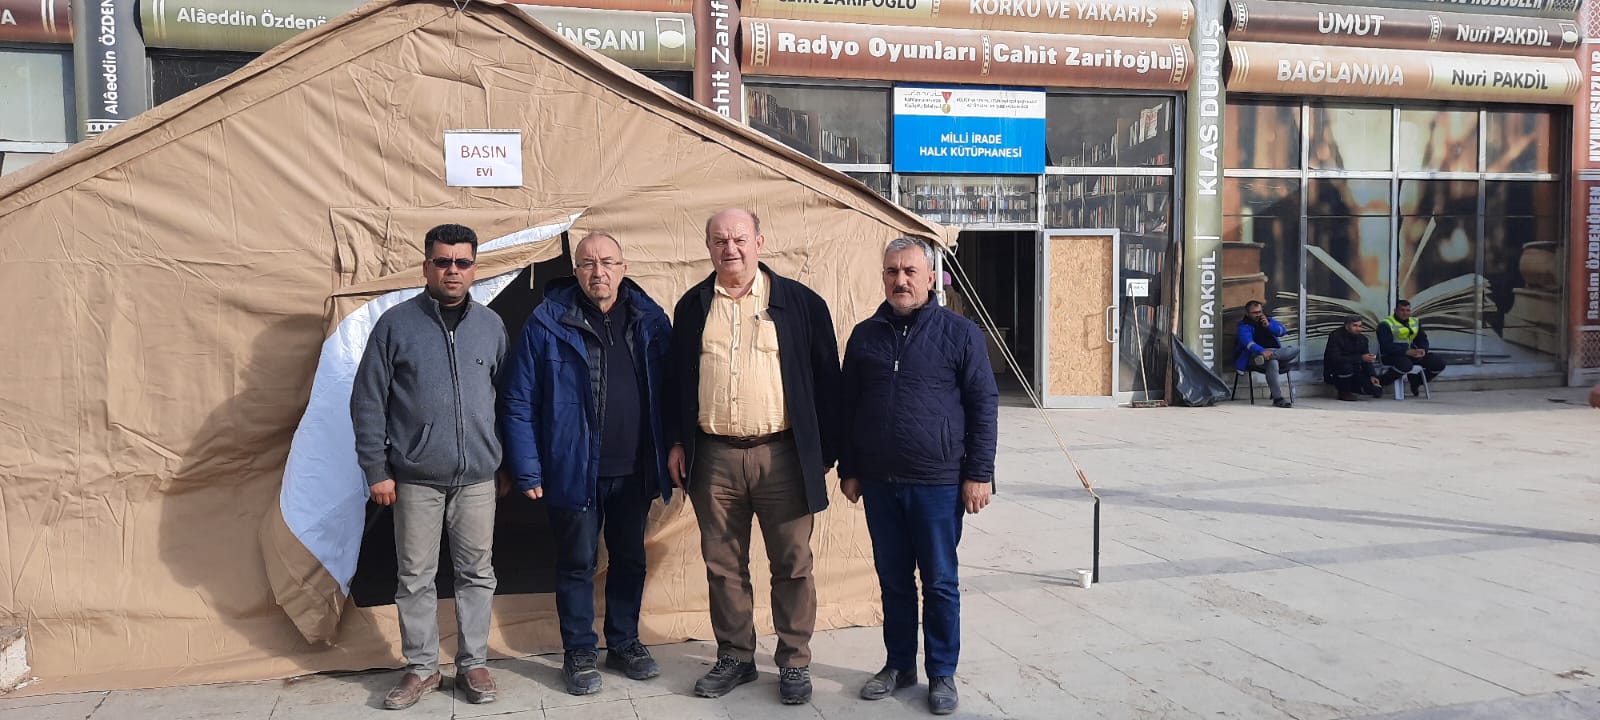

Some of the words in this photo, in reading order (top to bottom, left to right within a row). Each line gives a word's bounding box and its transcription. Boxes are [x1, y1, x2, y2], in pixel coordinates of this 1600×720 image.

[176, 7, 257, 27] Alâeddin
[969, 0, 1041, 18] KORKU
[1046, 0, 1071, 19] VE
[1076, 1, 1158, 28] YAKARIŞ
[1317, 12, 1385, 36] UMUT
[1456, 24, 1490, 42] Nuri
[1493, 25, 1552, 47] PAKDİL
[777, 32, 860, 60] Radyo
[868, 37, 976, 63] Oyunları
[993, 43, 1057, 65] Cahit
[1065, 47, 1172, 74] Zarifoğlu
[1200, 19, 1224, 117] DURUŞ
[102, 50, 118, 115] Alâeddin
[1277, 57, 1405, 86] BAĞLANMA
[1452, 69, 1486, 87] Nuri
[1492, 70, 1549, 90] PAKDİL
[711, 70, 730, 118] ahit
[461, 145, 507, 158] BASIN
[919, 146, 948, 157] HALK
[950, 145, 1022, 158] KÜTÜPHANESİ
[941, 131, 969, 144] MİLLİ
[971, 131, 1002, 144] İRADE
[1199, 124, 1218, 196] KLAS
[1197, 250, 1216, 329] PAKDİL
